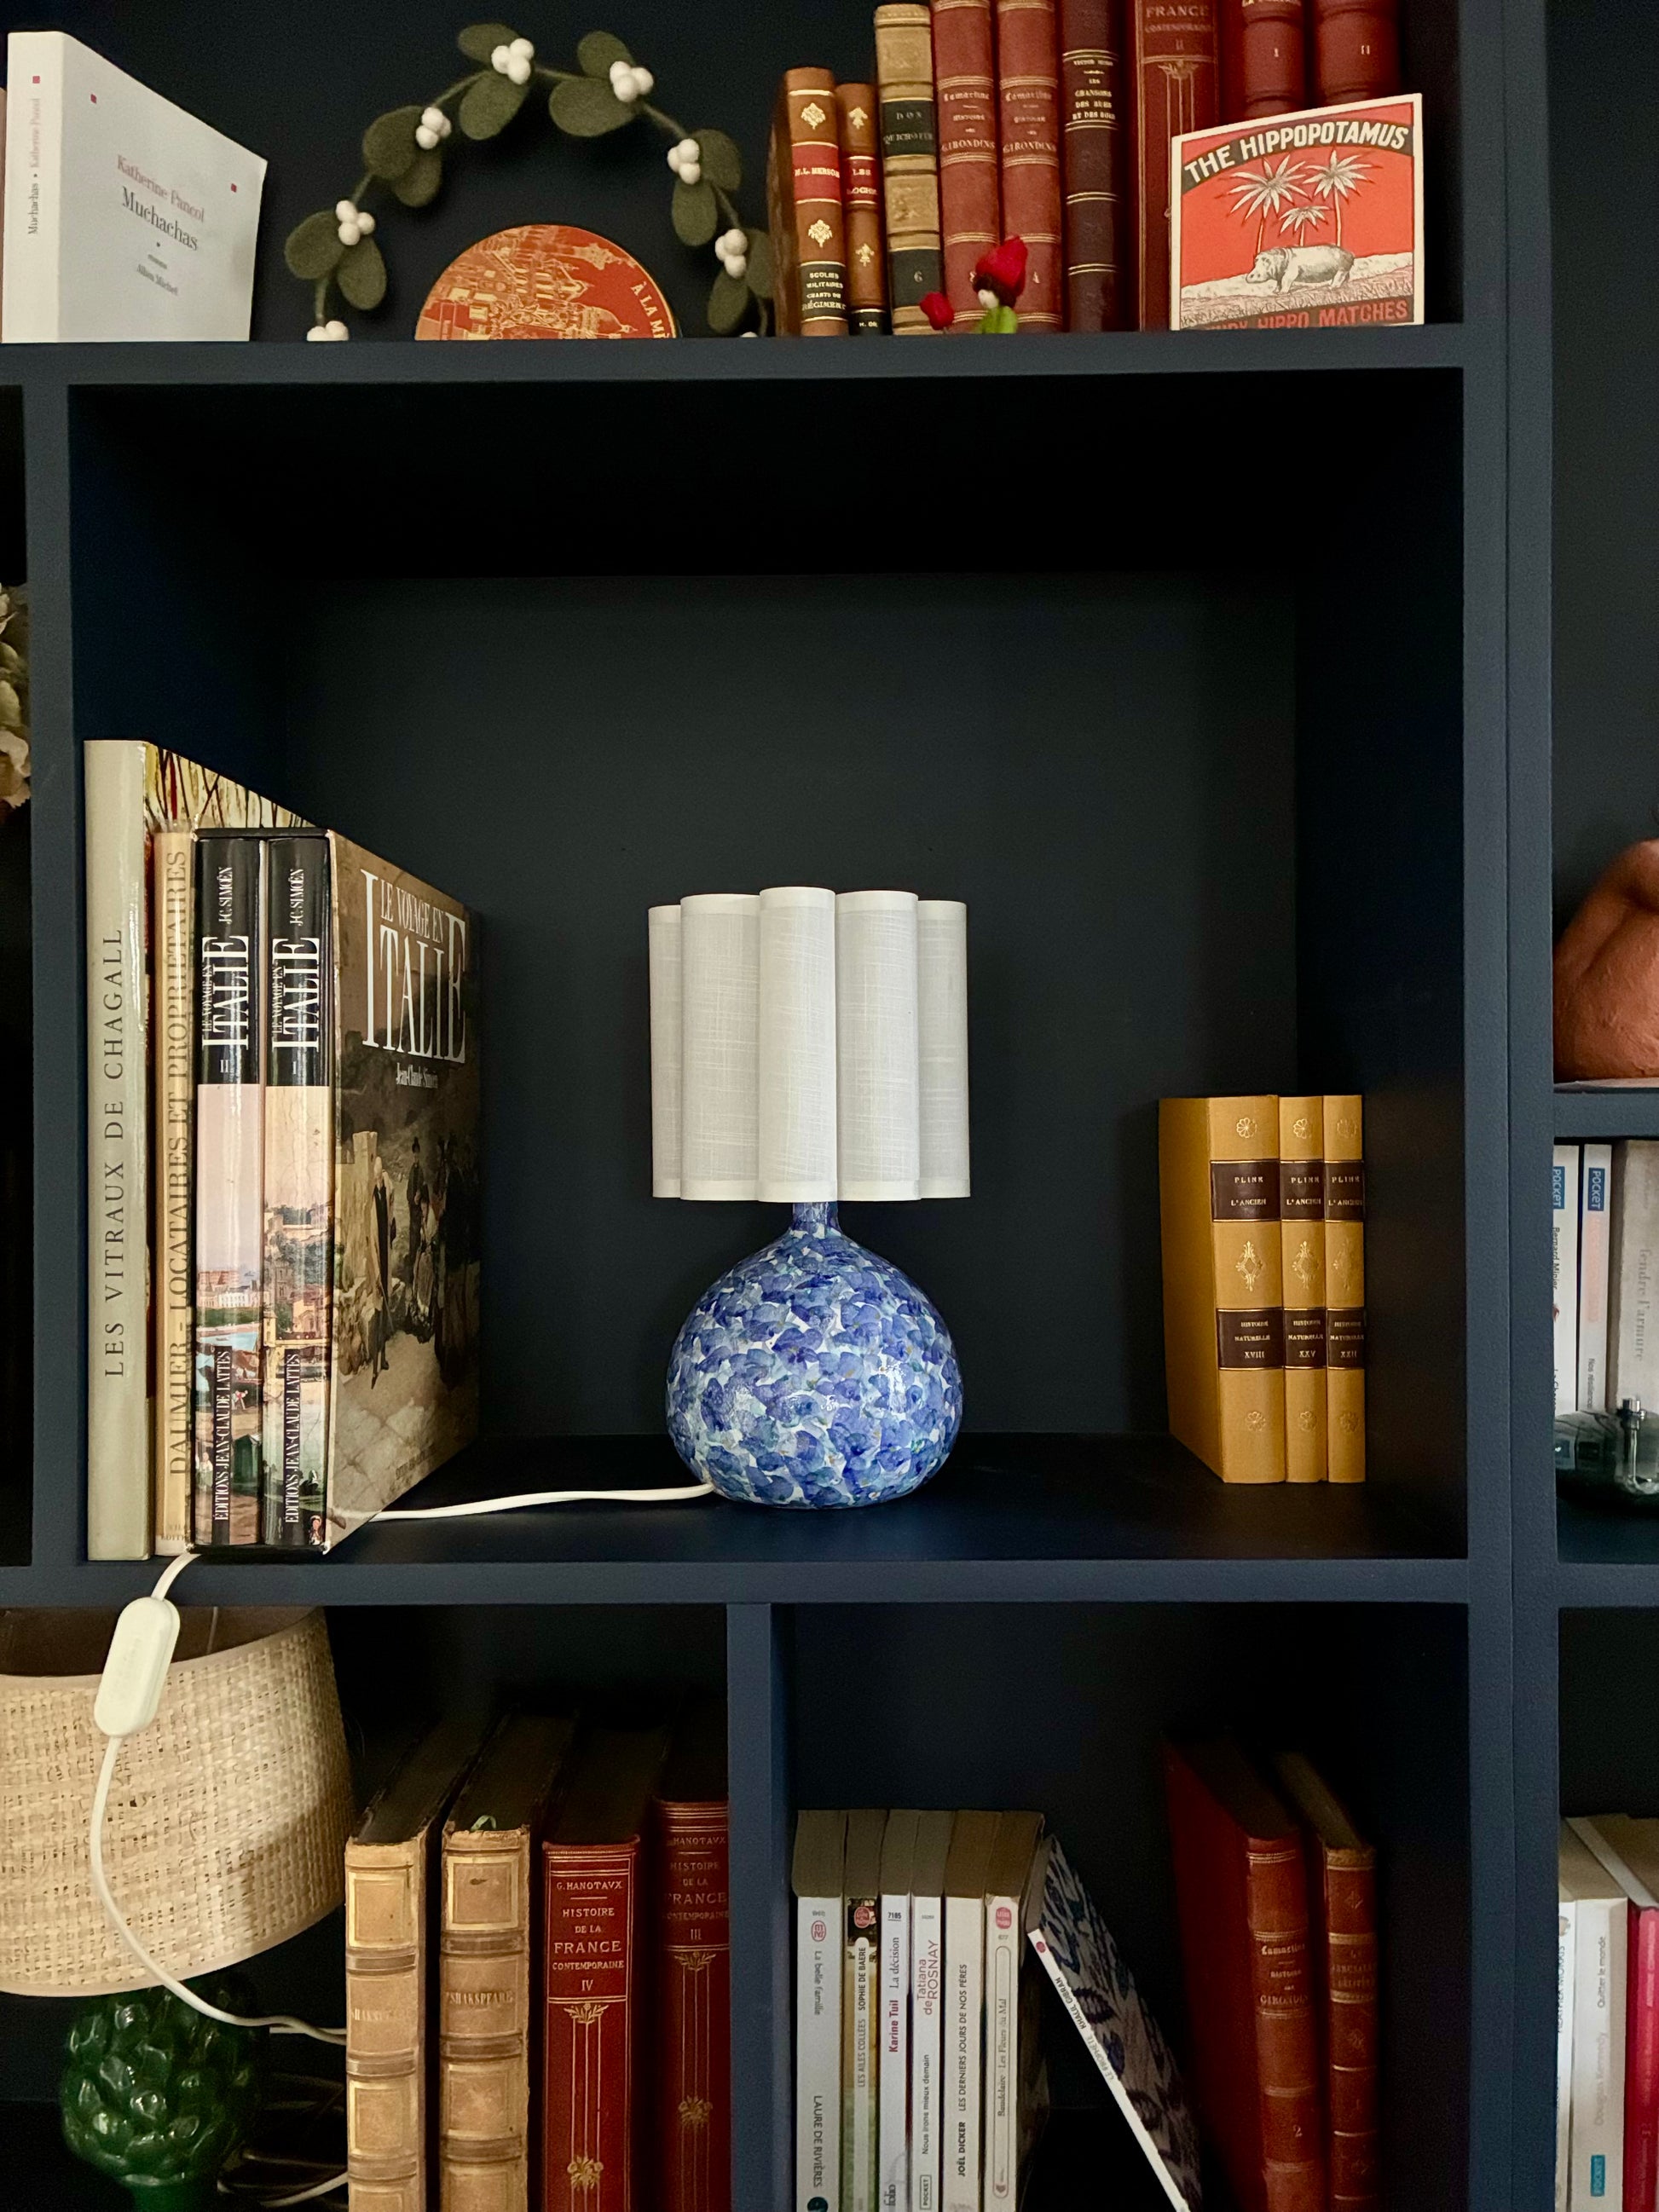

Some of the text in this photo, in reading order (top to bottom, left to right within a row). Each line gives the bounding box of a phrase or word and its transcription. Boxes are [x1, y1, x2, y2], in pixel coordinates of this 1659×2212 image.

[1146, 5, 1209, 17] FRANCE
[941, 139, 995, 152] GIRONDINS
[1003, 141, 1057, 153] GIRONDINS
[1183, 121, 1409, 183] THE HIPPOPOTAMUS
[28, 183, 39, 234] Muchachas
[118, 154, 205, 222] Katherine Pancol
[122, 186, 198, 251] Muchachas
[913, 270, 923, 282] 6
[639, 294, 657, 316] LA
[1319, 300, 1408, 327] MATCHES
[380, 879, 444, 944] LE VOYAGE EN
[361, 869, 465, 1064] ITALIE
[202, 936, 249, 1050] ITALIE
[272, 938, 320, 1052] ITALIE
[220, 1060, 228, 1072] II
[168, 1092, 187, 1123] ET
[103, 930, 124, 1377] LES VITRAUX DE CHAGALL
[169, 1137, 188, 1309] LOCATAIRES
[170, 1343, 187, 1474] DAUMIER
[215, 1394, 231, 1469] JEAN-CLAUDE
[286, 1396, 300, 1471] JEAN-CLAUDE
[563, 1908, 615, 1917] HISTOIRE
[552, 1961, 624, 1970] CONTEMPORAINE
[554, 1941, 621, 1954] FRANCE
[889, 1937, 899, 1989] La décision
[581, 1979, 593, 1991] IV
[858, 1972, 865, 1983] DE
[917, 1960, 926, 2001] Tatiana
[923, 1940, 939, 2015] de ROSNAY
[1055, 1977, 1072, 2004] GIBRAN
[1597, 1978, 1605, 2008] Quitter
[889, 2000, 899, 2052] Karine Tuil
[959, 2012, 967, 2024] DE
[1071, 2004, 1087, 2030] KHALIL
[997, 2075, 1006, 2117] Baudelaire
[813, 2096, 825, 2188] LAURE DE RIVIÈRES
[957, 2122, 966, 2176] JOËL DICKER
[1292, 2124, 1303, 2137] 2
[884, 2185, 896, 2207] folio
